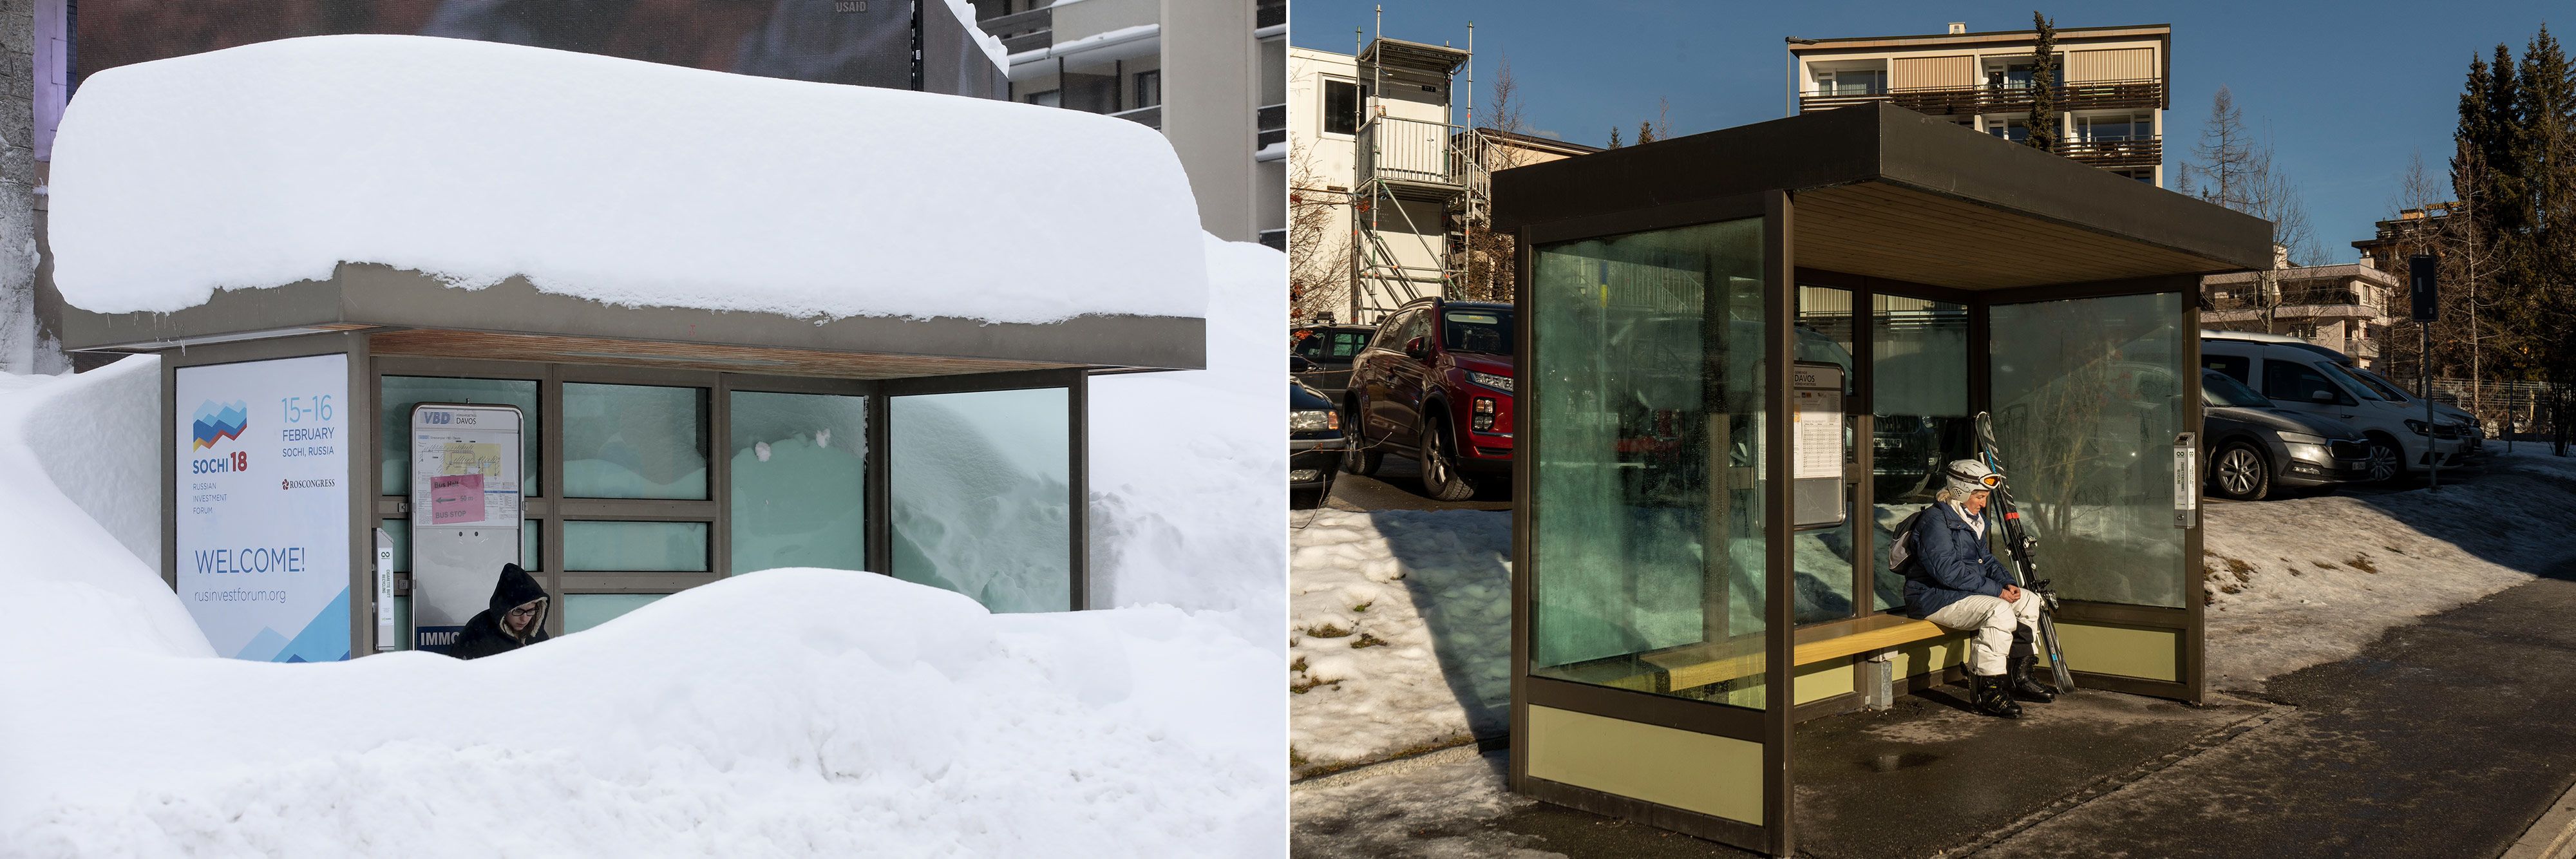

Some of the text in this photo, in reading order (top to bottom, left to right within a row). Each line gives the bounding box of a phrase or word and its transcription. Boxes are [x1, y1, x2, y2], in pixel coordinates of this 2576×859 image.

[836, 1, 866, 12] USAID
[424, 412, 451, 424] VBD
[283, 427, 335, 442] FEBRUARY
[282, 446, 334, 457] SOCHI, RUSSIA
[193, 451, 247, 475] SOCHI 18
[290, 478, 336, 489] ROSCONGRESS
[193, 494, 227, 502] INVESTMENT
[195, 547, 305, 574] WELCOME!
[194, 587, 286, 603] rusinvestforum.org
